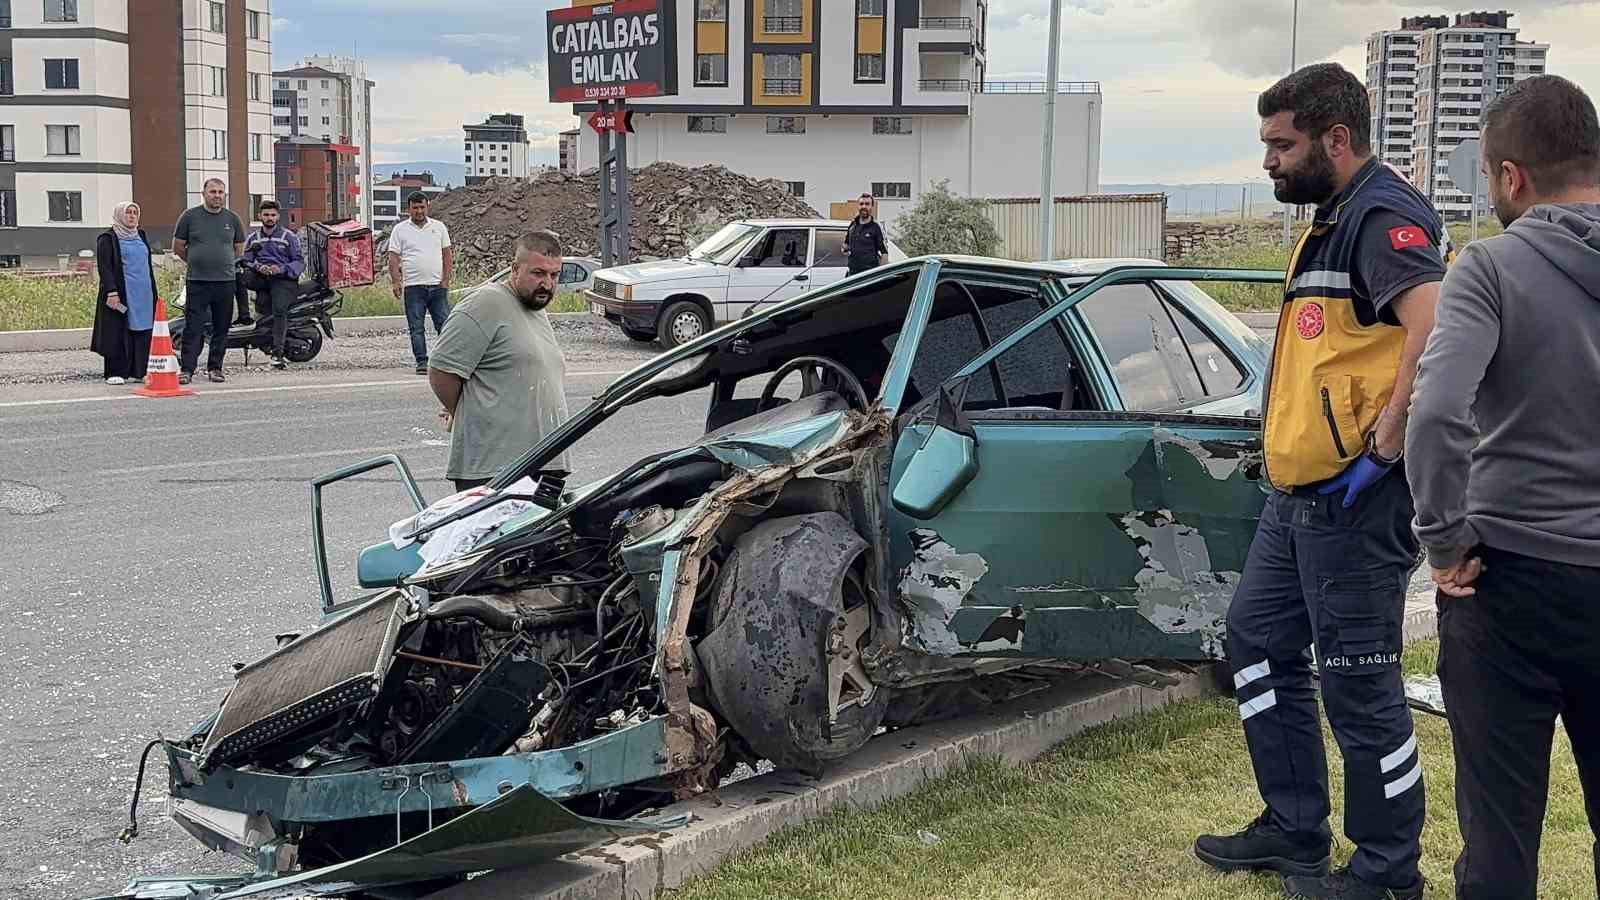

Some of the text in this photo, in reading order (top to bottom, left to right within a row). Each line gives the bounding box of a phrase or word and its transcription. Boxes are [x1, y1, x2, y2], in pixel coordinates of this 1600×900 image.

[571, 51, 639, 84] EMLAK
[597, 116, 606, 128] 20
[1325, 656, 1352, 667] ACİL
